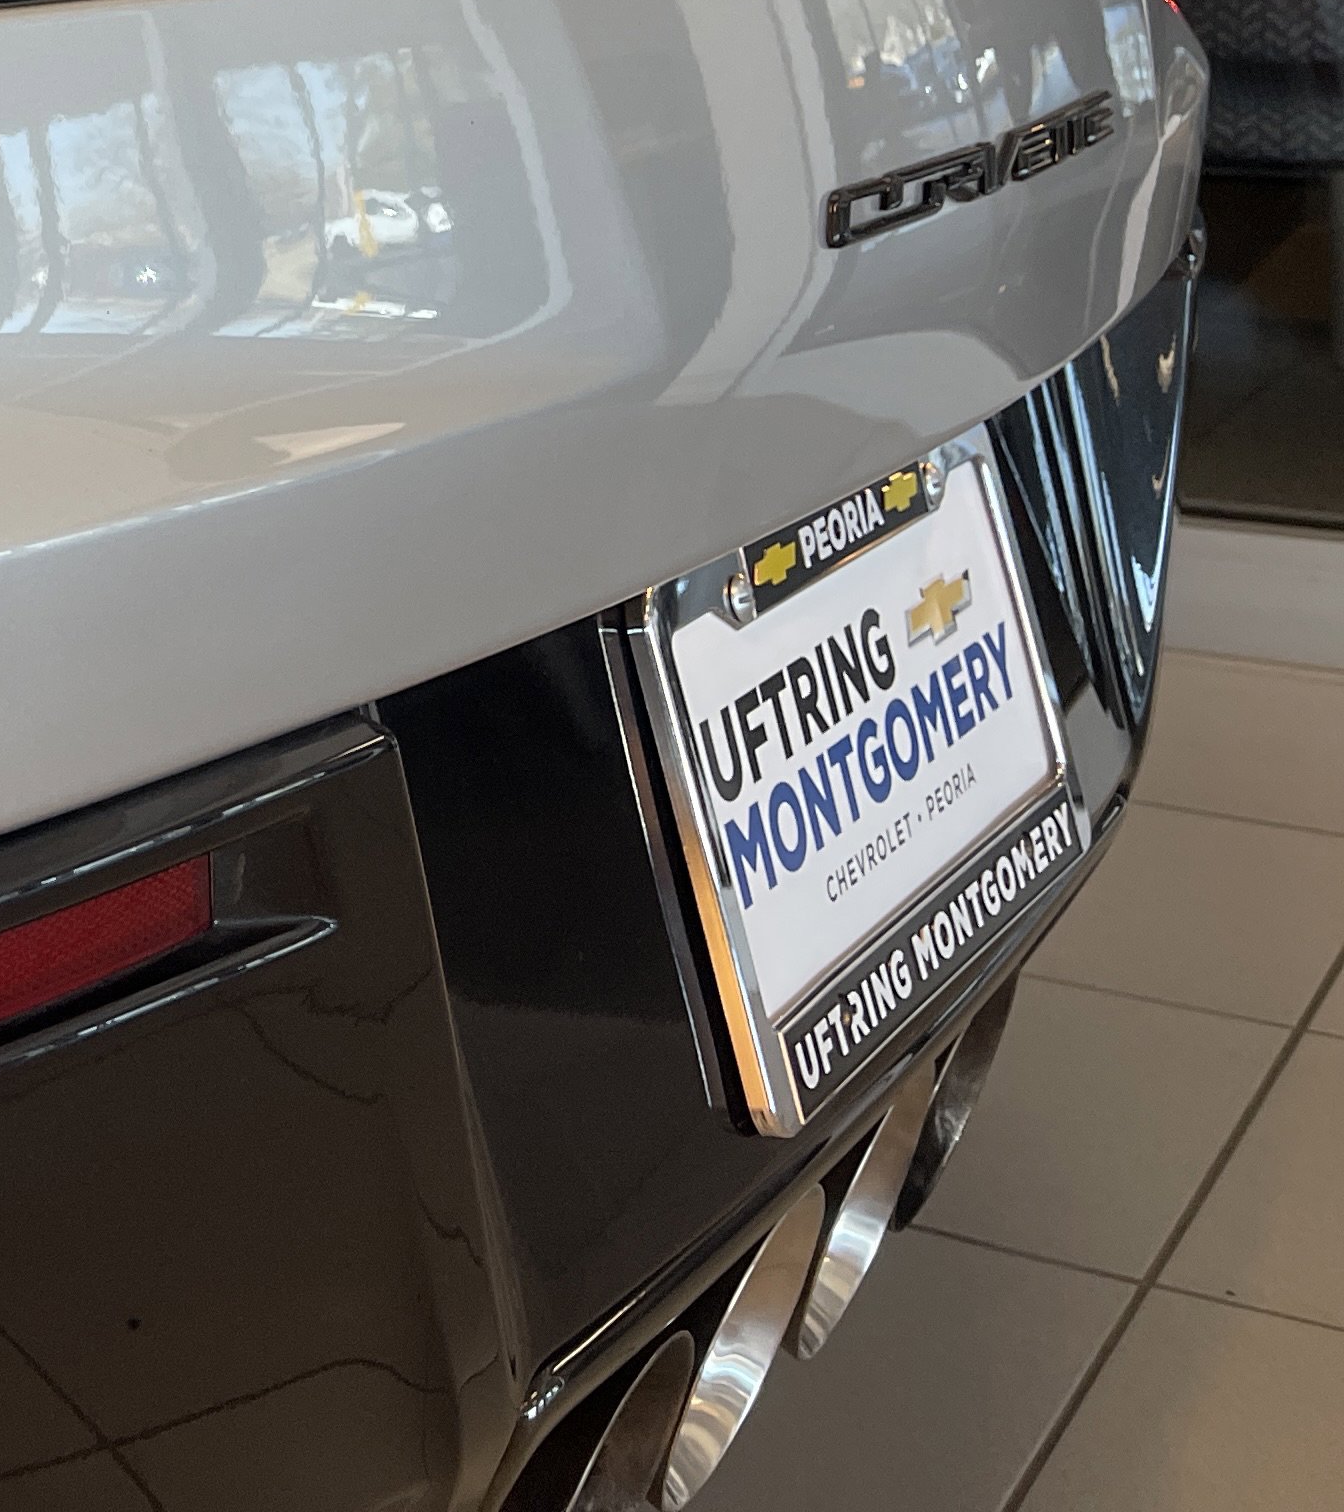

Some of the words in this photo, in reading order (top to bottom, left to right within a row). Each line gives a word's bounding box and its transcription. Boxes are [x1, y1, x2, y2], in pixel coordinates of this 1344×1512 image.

[797, 488, 885, 568] PEORIA
[698, 608, 896, 802] UFTRING
[723, 621, 1014, 910] MONTGOMERY
[825, 811, 913, 903] CHEVROLET
[925, 762, 978, 822] PEORIA
[794, 950, 913, 1090] UFTRING
[911, 801, 1075, 981] MONTGOMERY
